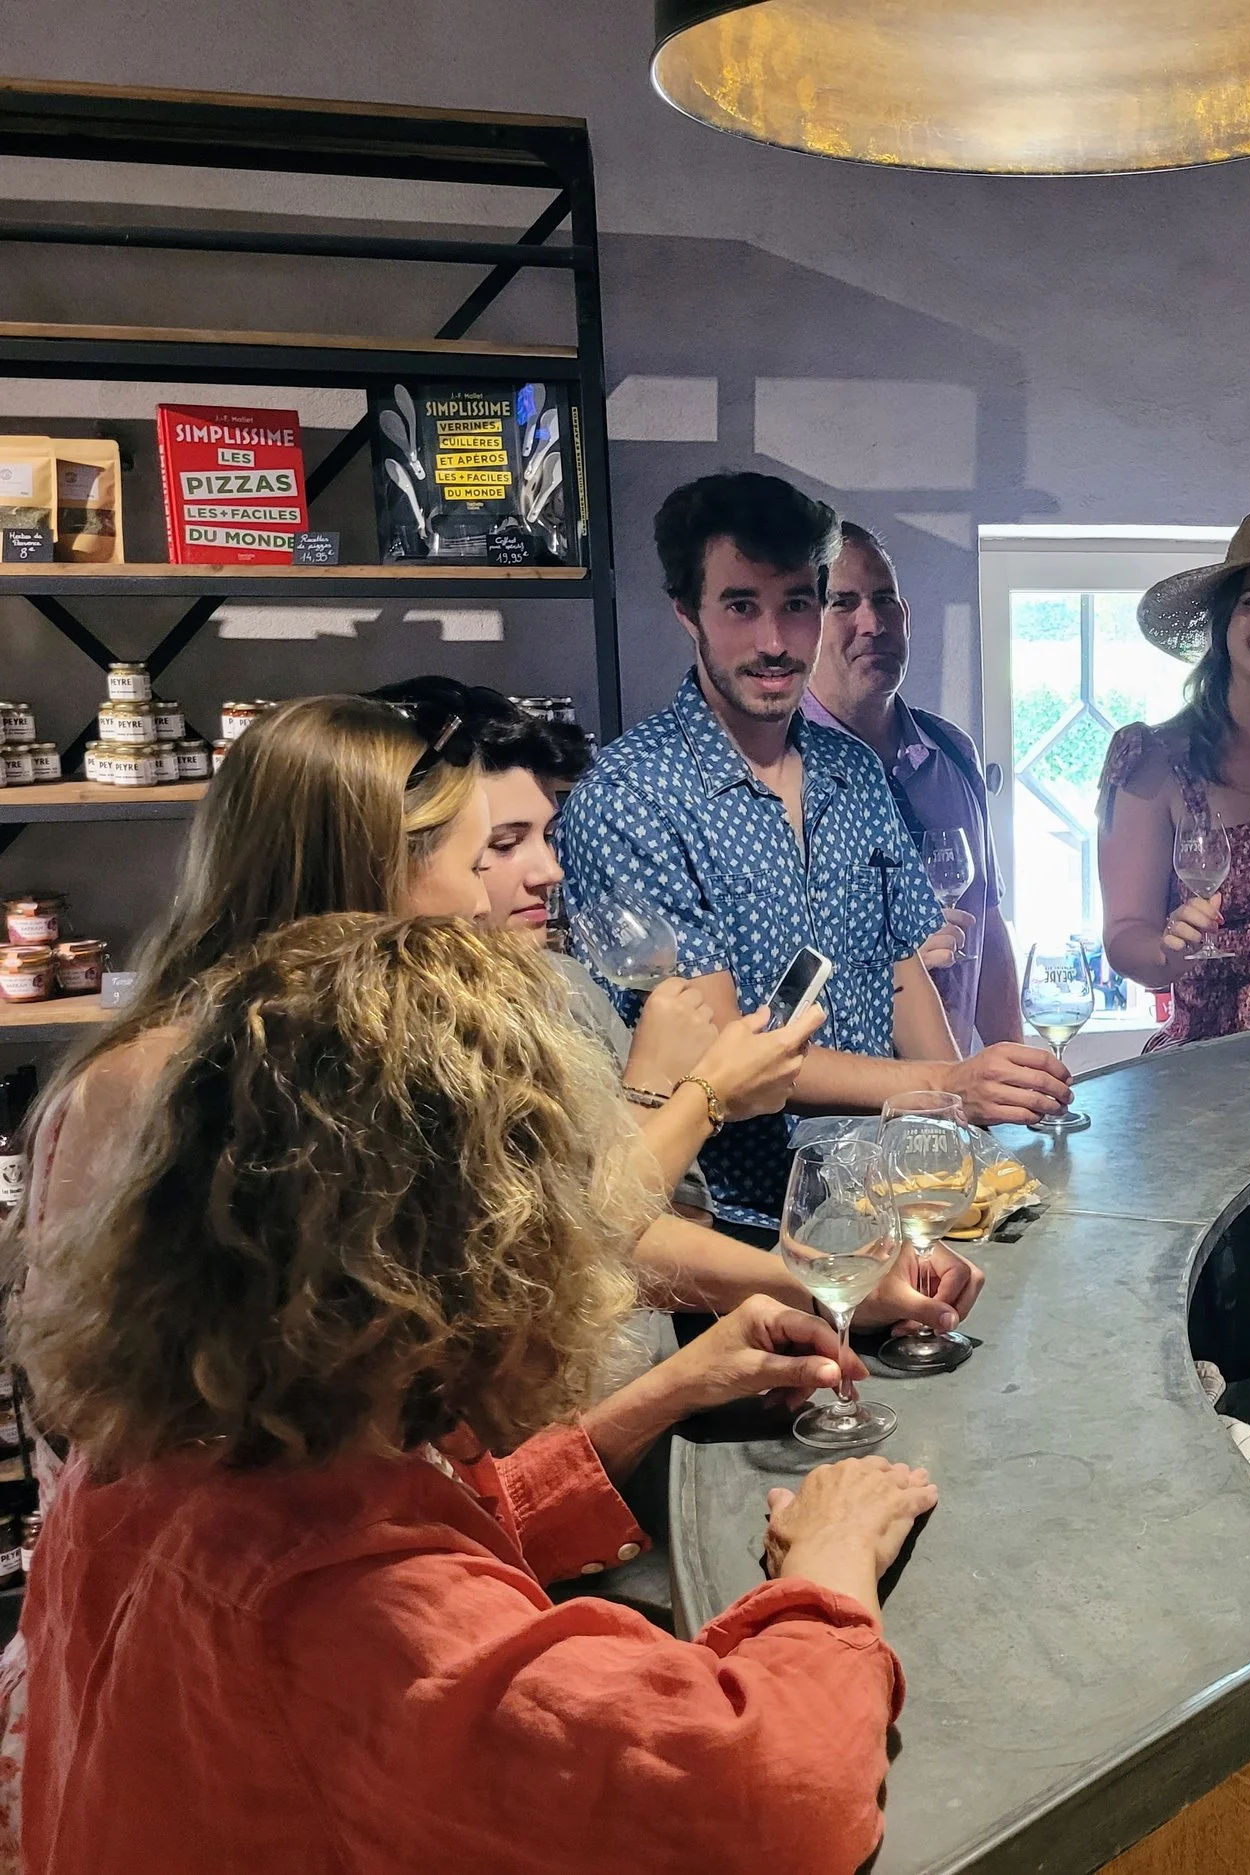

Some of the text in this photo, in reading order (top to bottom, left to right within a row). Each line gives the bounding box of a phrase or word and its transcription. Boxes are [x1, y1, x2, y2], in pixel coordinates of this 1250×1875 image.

[426, 401, 511, 416] SIMPLISSIME
[439, 421, 500, 432] VERRINES,
[175, 424, 295, 447] SIMPLISSIME
[221, 451, 252, 464] LES
[440, 453, 505, 466] ET APÉROS
[186, 473, 293, 495] PIZZAS
[438, 472, 457, 481] LES
[467, 473, 509, 483] FACILES
[447, 488, 503, 498] DU MONDE
[187, 508, 218, 519] LES
[231, 508, 298, 521] FACILES
[189, 528, 218, 542] DU
